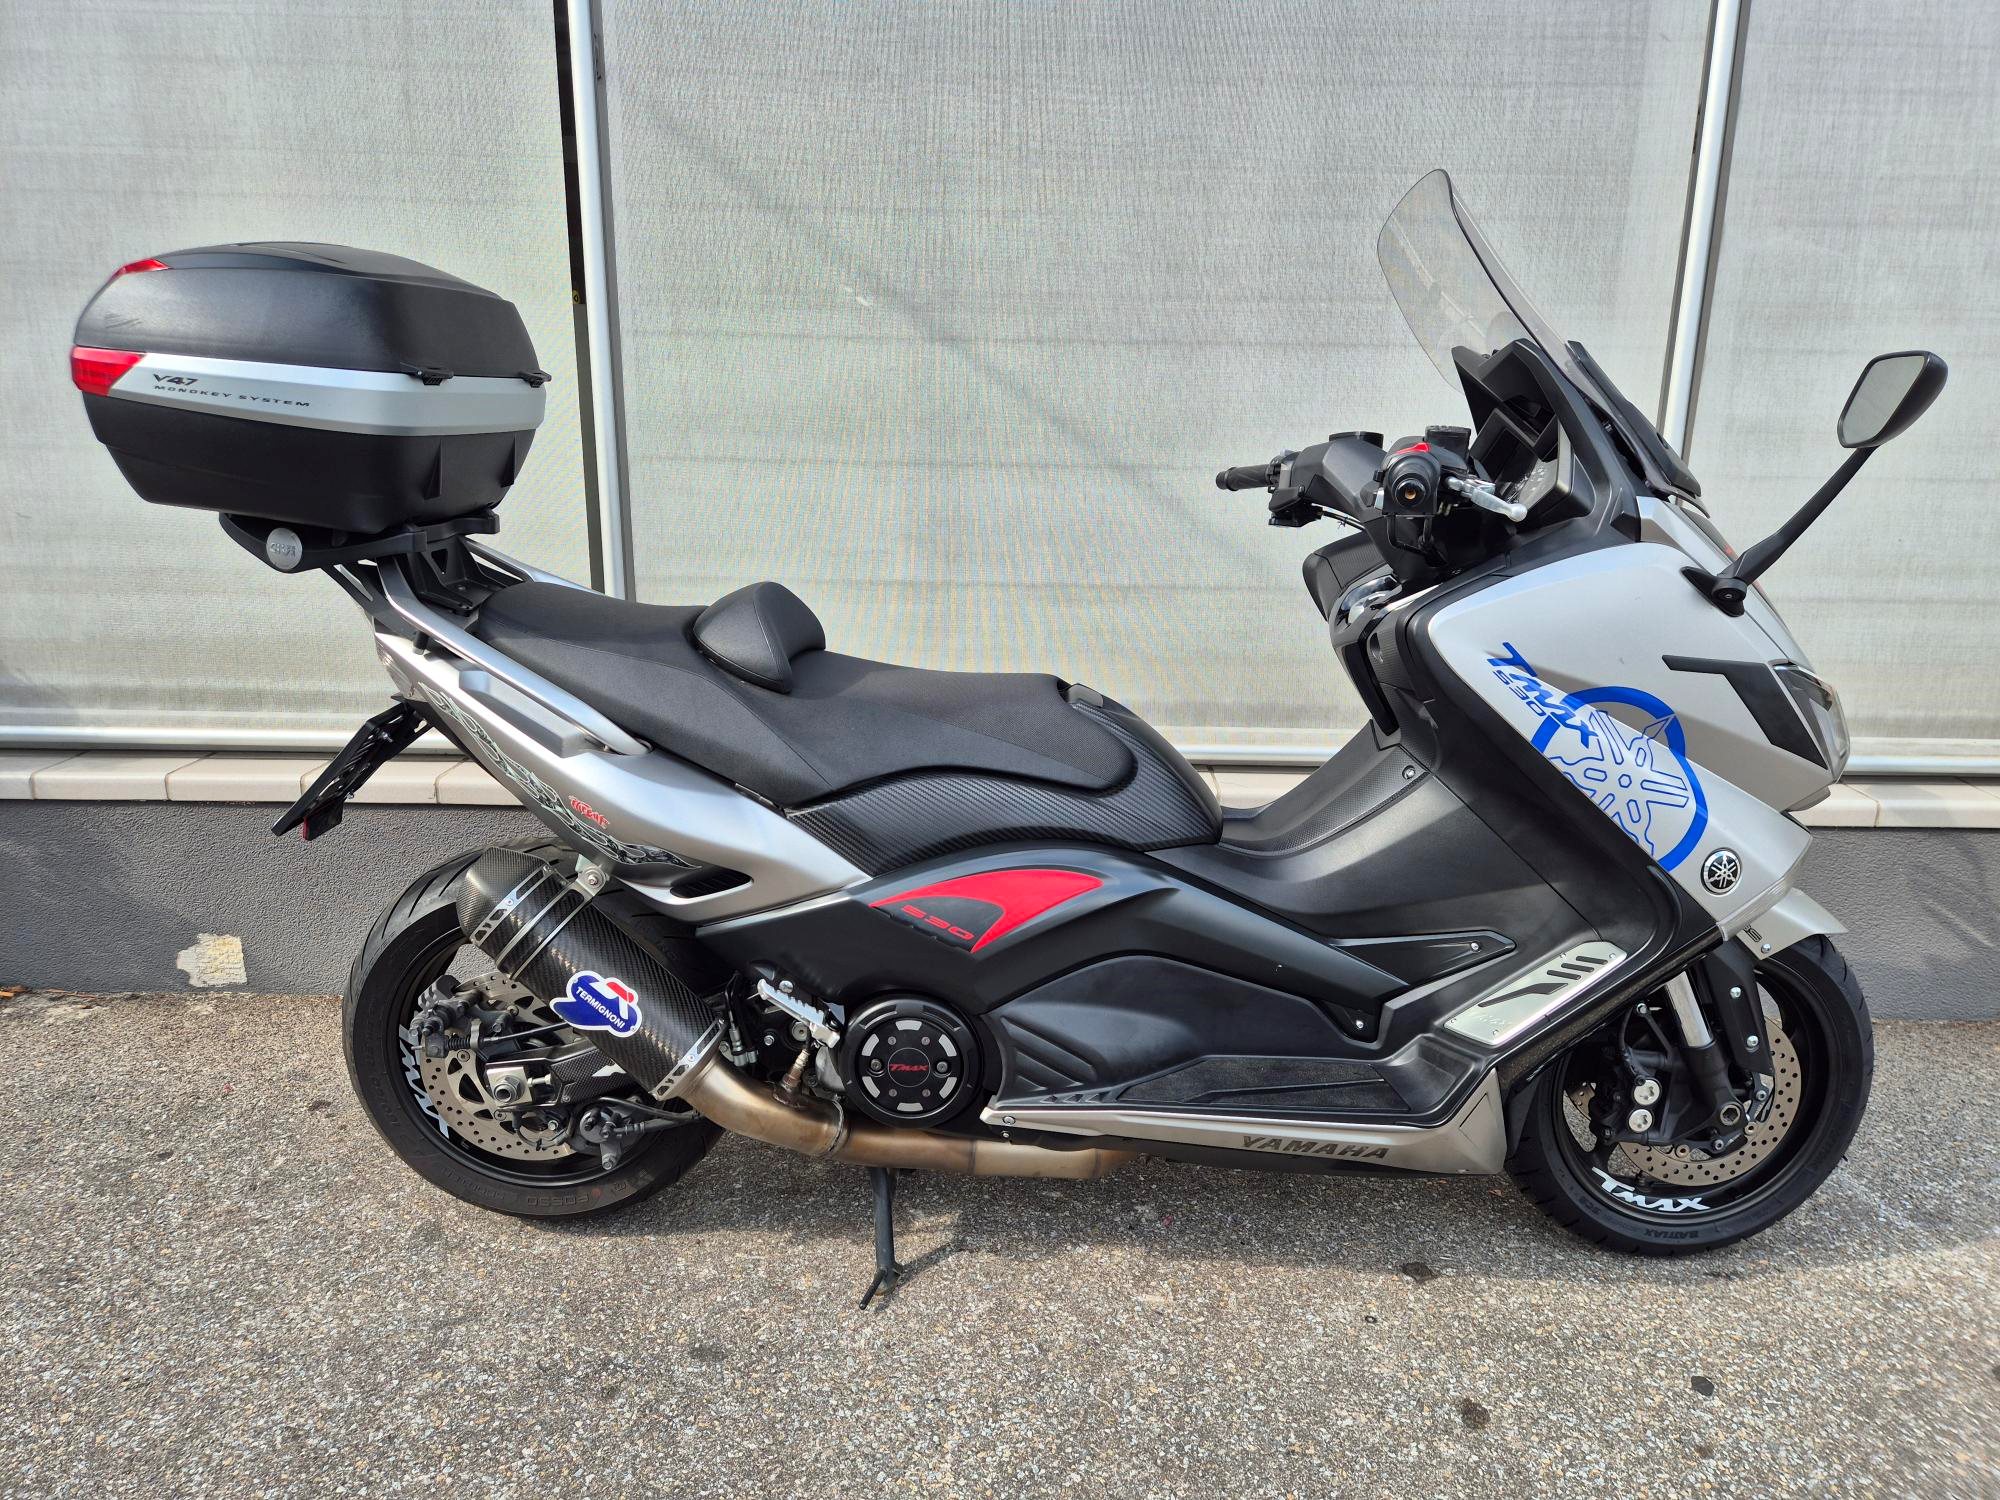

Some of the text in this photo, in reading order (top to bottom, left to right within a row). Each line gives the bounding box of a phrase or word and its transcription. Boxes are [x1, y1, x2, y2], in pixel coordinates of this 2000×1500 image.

[153, 373, 199, 386] V47
[154, 385, 310, 407] MONOKEY SYSTEM
[1492, 669, 1547, 717] 530
[575, 986, 626, 1030] TERMIGNONI
[1242, 1135, 1390, 1160] YAMAHA
[1591, 1166, 1712, 1212] TMAX
